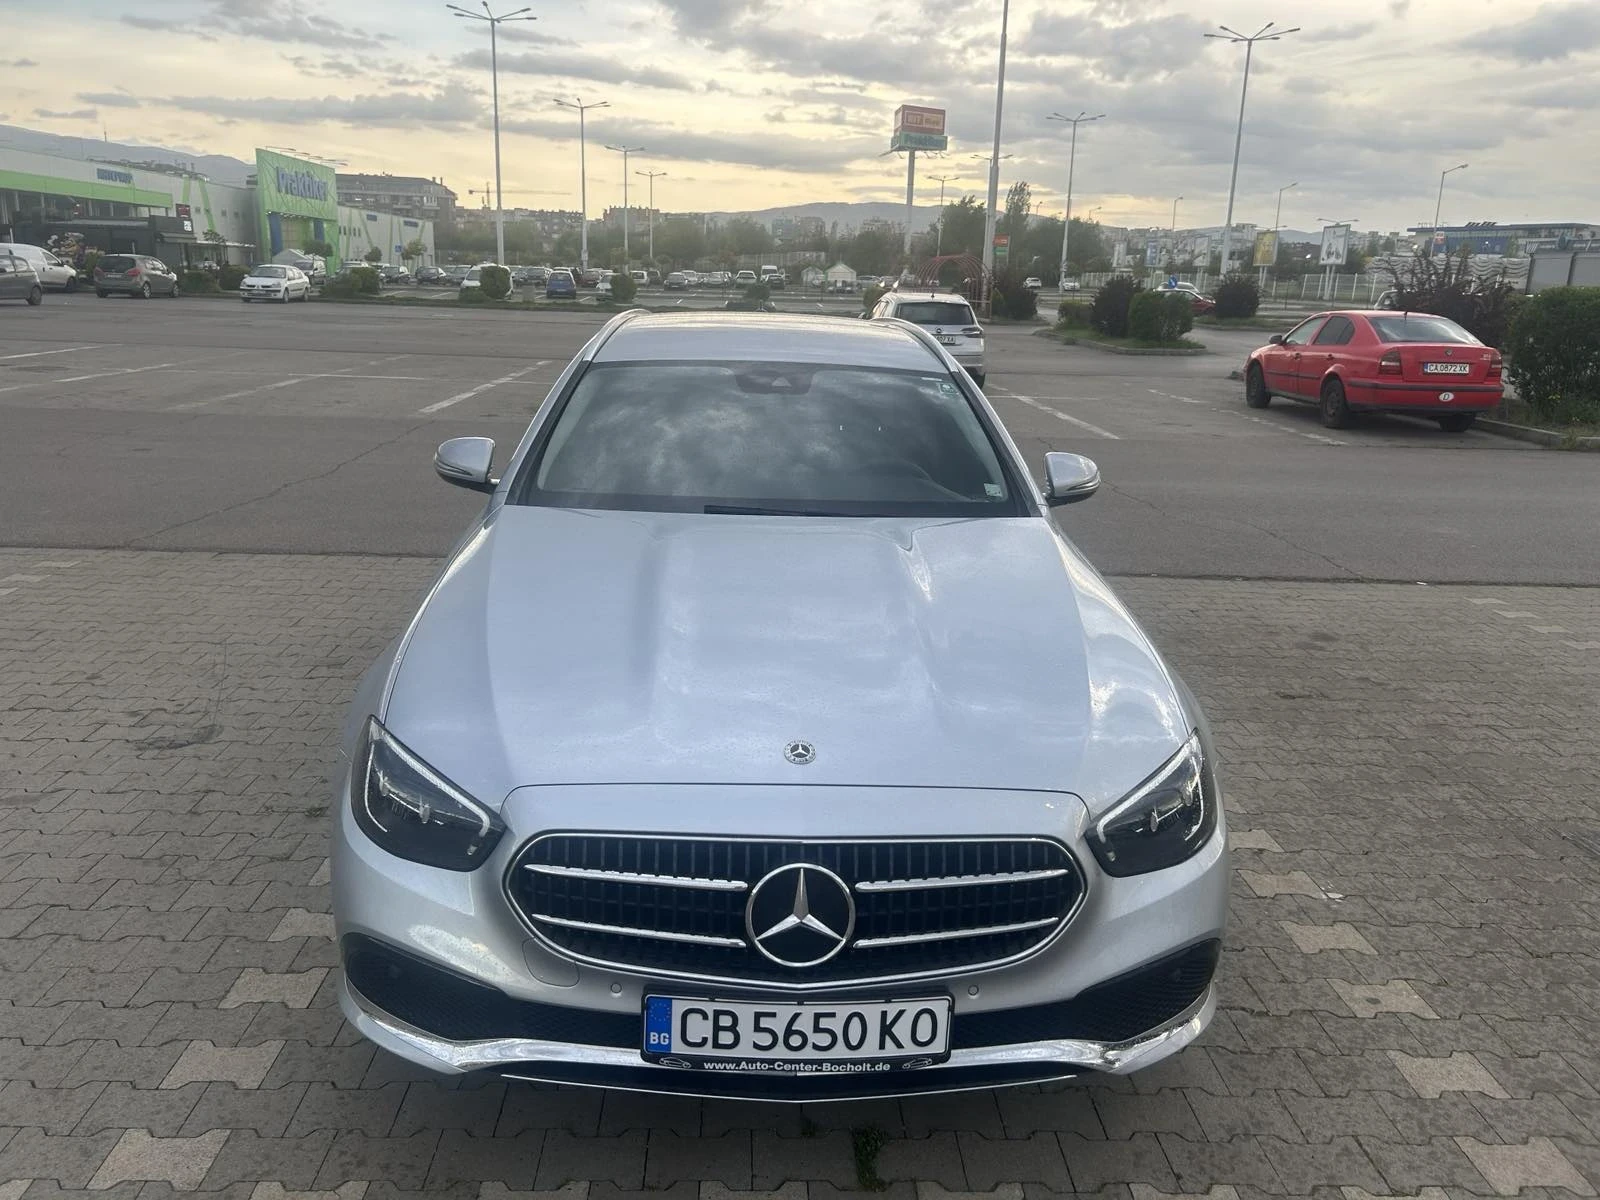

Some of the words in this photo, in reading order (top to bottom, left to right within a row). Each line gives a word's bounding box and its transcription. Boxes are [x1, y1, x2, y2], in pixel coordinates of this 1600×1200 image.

[276, 166, 328, 202] Praktiker
[1429, 364, 1439, 372] CA
[1440, 364, 1457, 372] 0872
[1458, 365, 1467, 373] XK
[1443, 393, 1450, 401] D
[679, 1007, 741, 1050] CB
[752, 1010, 868, 1052] 5650
[878, 1007, 938, 1050] KO
[649, 1032, 670, 1046] BG
[703, 1060, 891, 1073] www.Auto-Center-Bocholt.de
